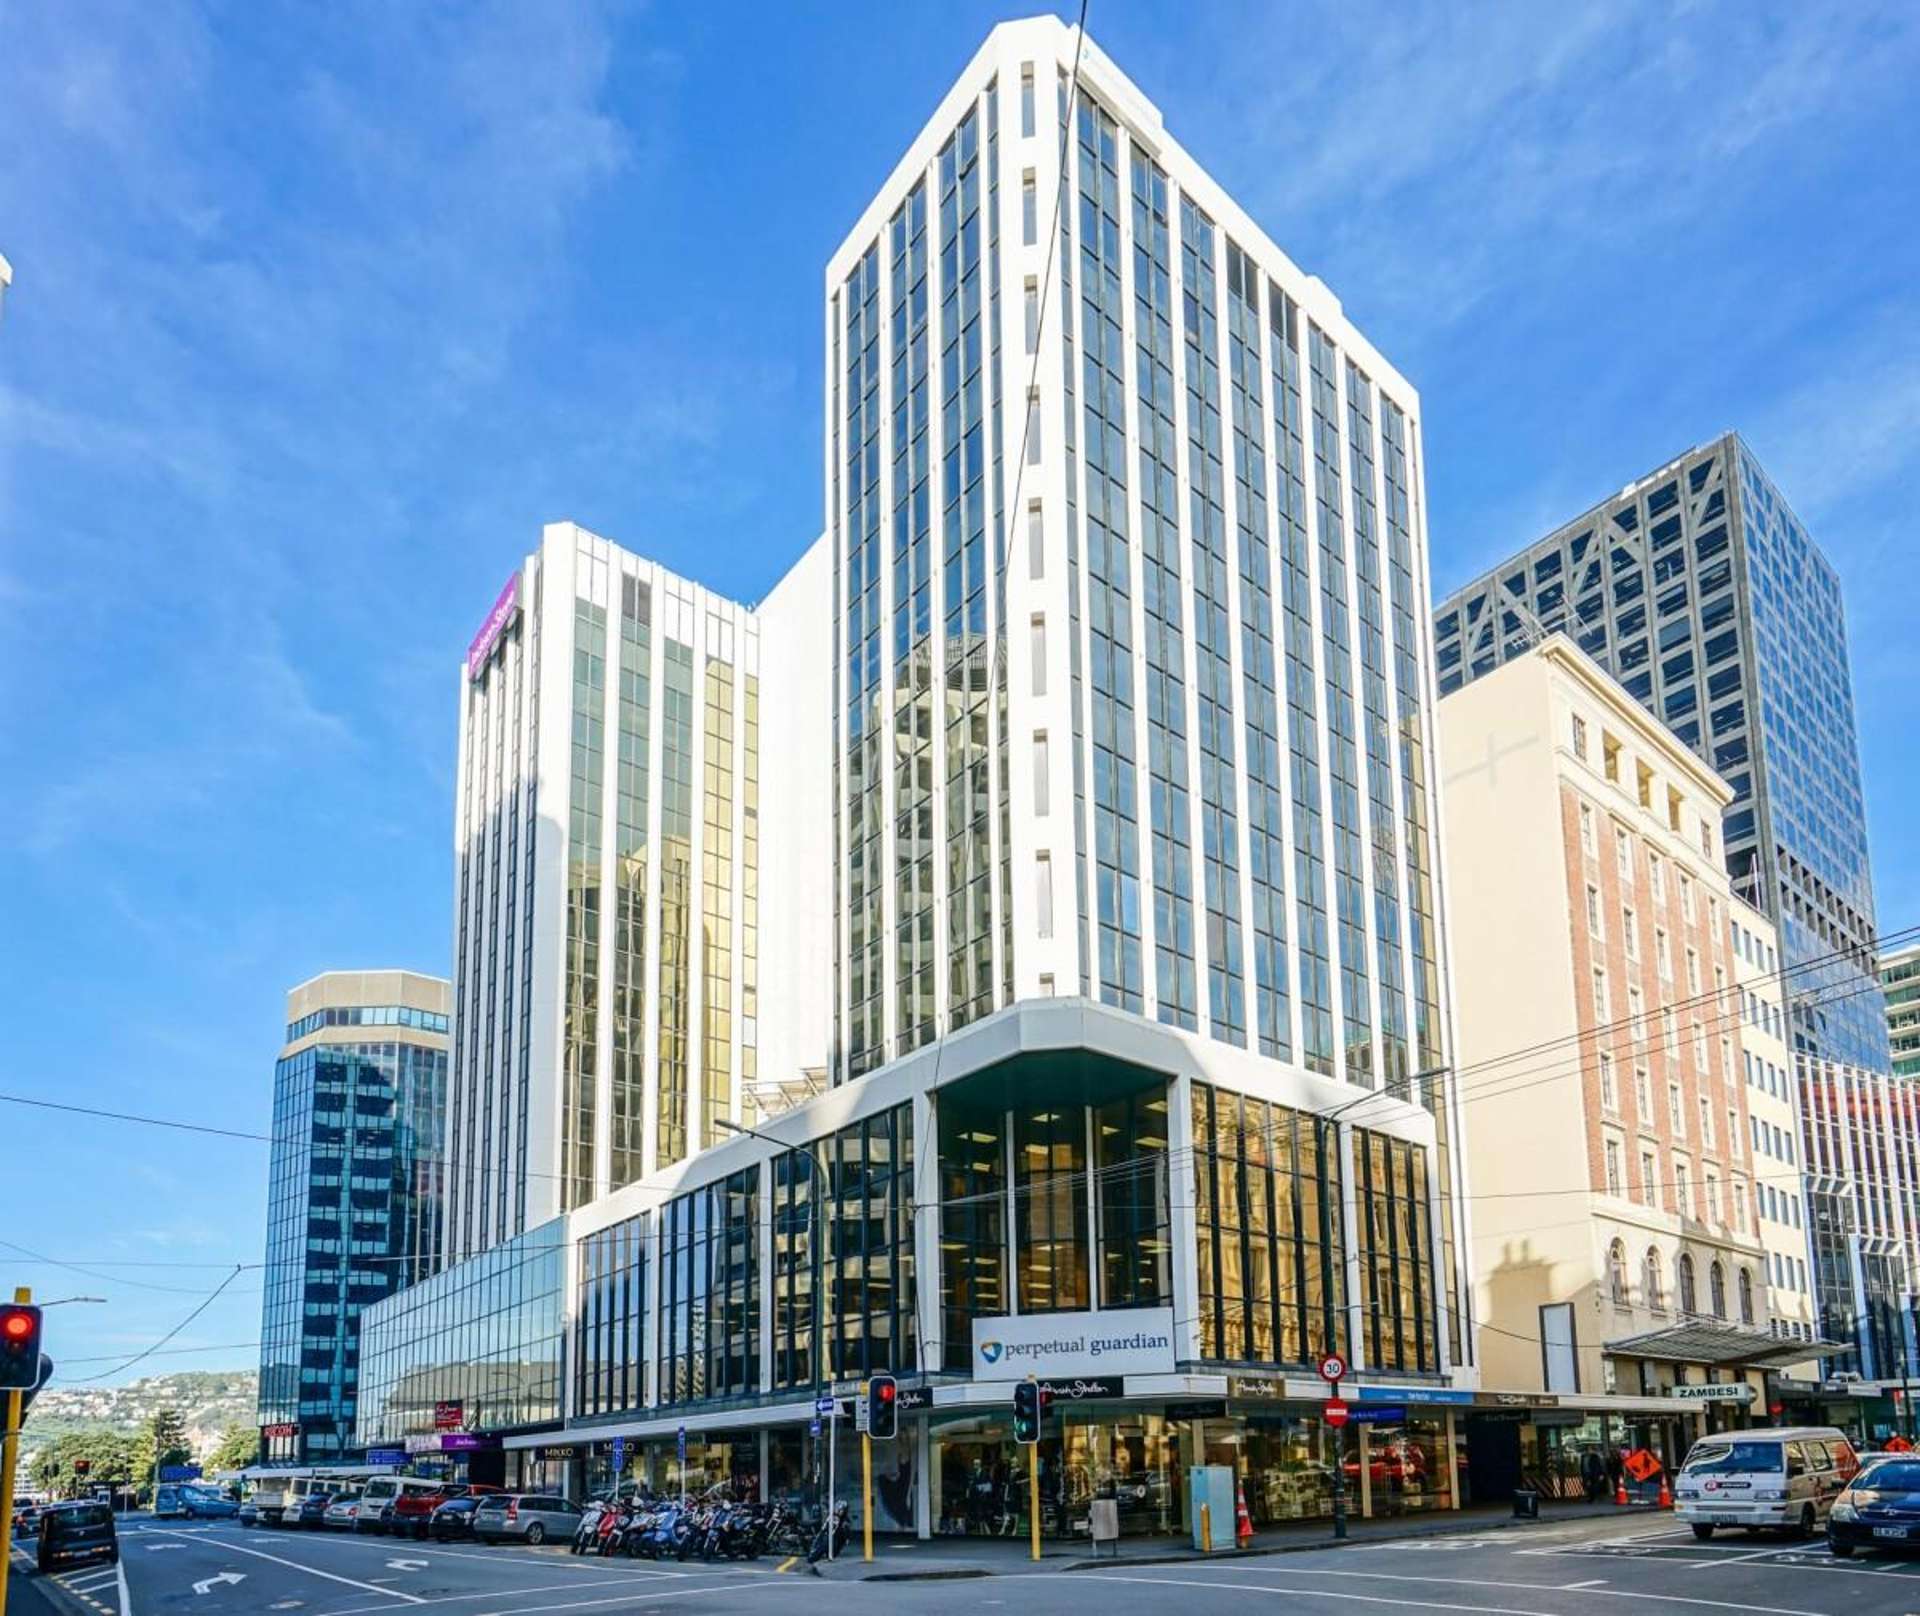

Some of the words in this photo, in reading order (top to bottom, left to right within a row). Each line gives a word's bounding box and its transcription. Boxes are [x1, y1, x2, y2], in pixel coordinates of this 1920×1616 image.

[1005, 1337, 1084, 1360] perpetual
[1090, 1333, 1168, 1356] guardian
[1326, 1363, 1340, 1374] 30
[1679, 1386, 1739, 1398] ZAMBESI
